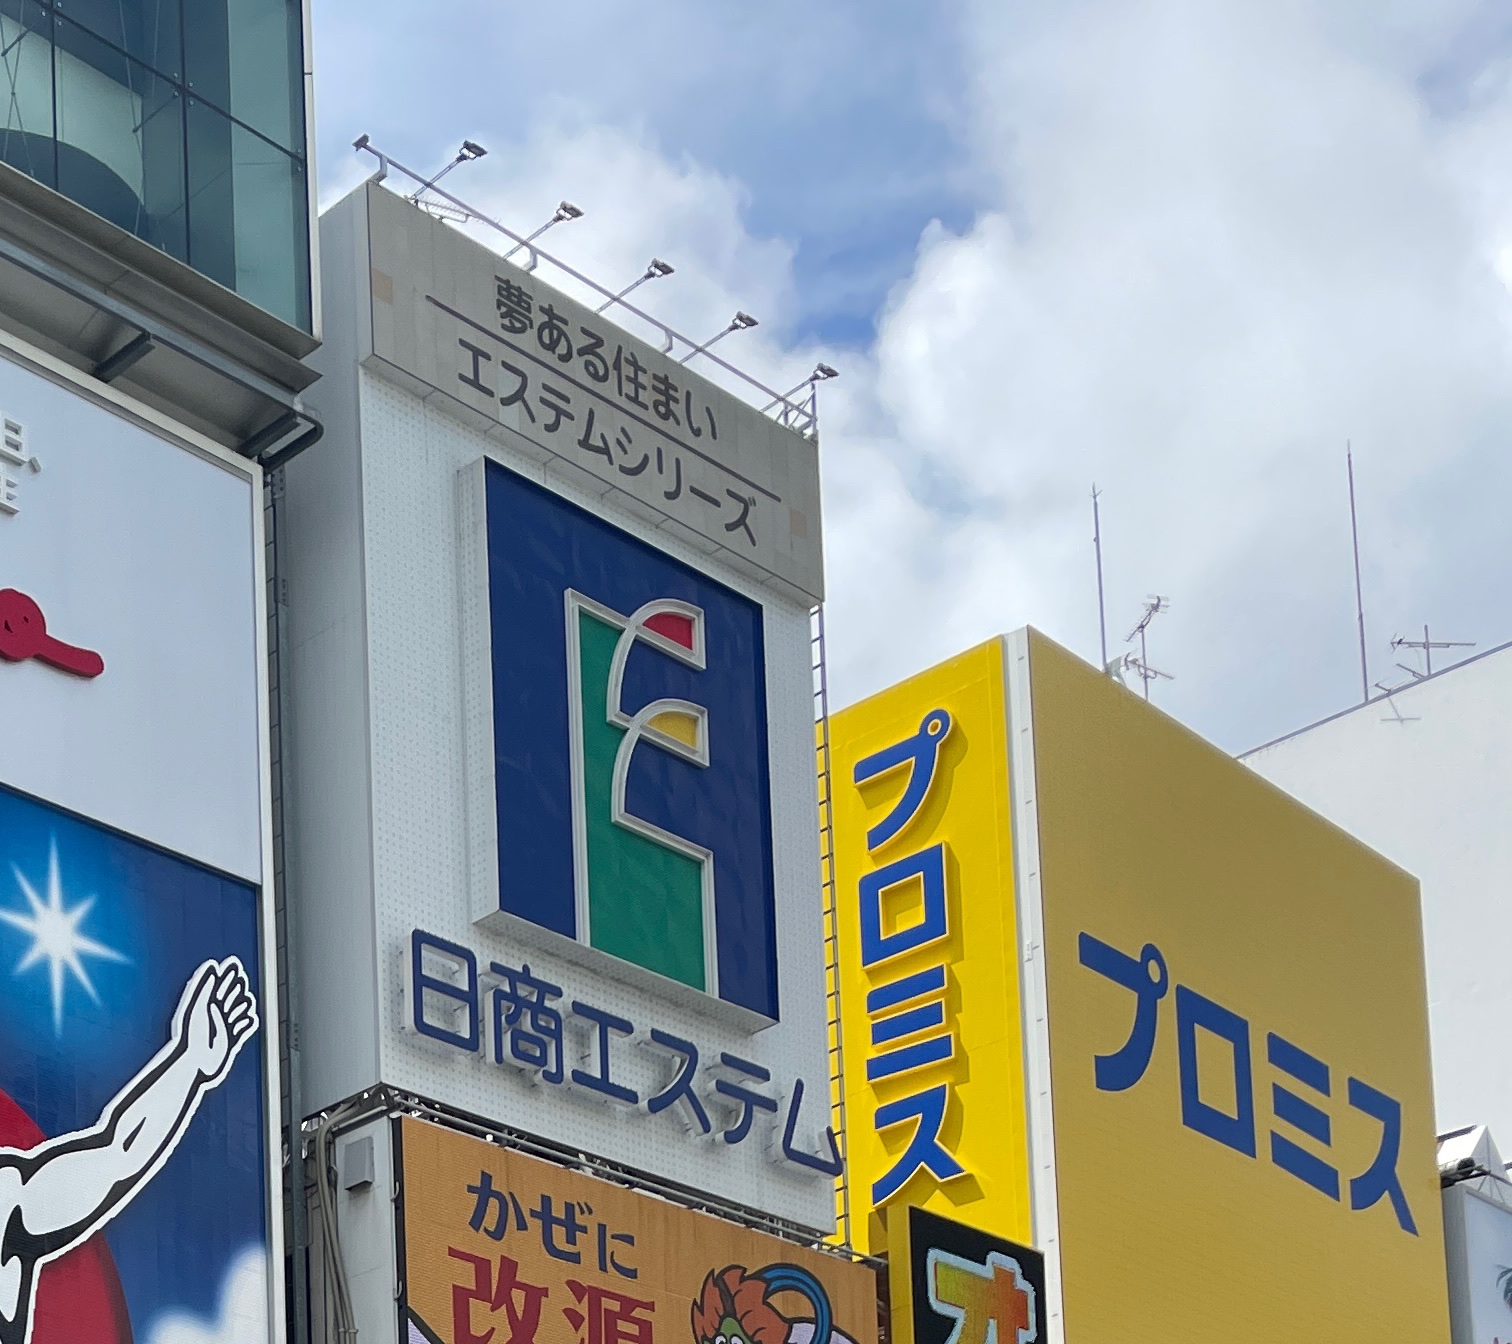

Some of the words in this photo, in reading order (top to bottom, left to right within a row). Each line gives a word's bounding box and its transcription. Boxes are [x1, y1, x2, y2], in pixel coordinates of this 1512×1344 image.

[458, 337, 757, 548] エステムシリーズ
[494, 274, 718, 441] 夢ある住まい
[411, 928, 843, 1177] 日商エステム
[853, 708, 968, 1208] プロミス
[1078, 931, 1419, 1238] プロミス
[466, 1170, 639, 1280] かぜに
